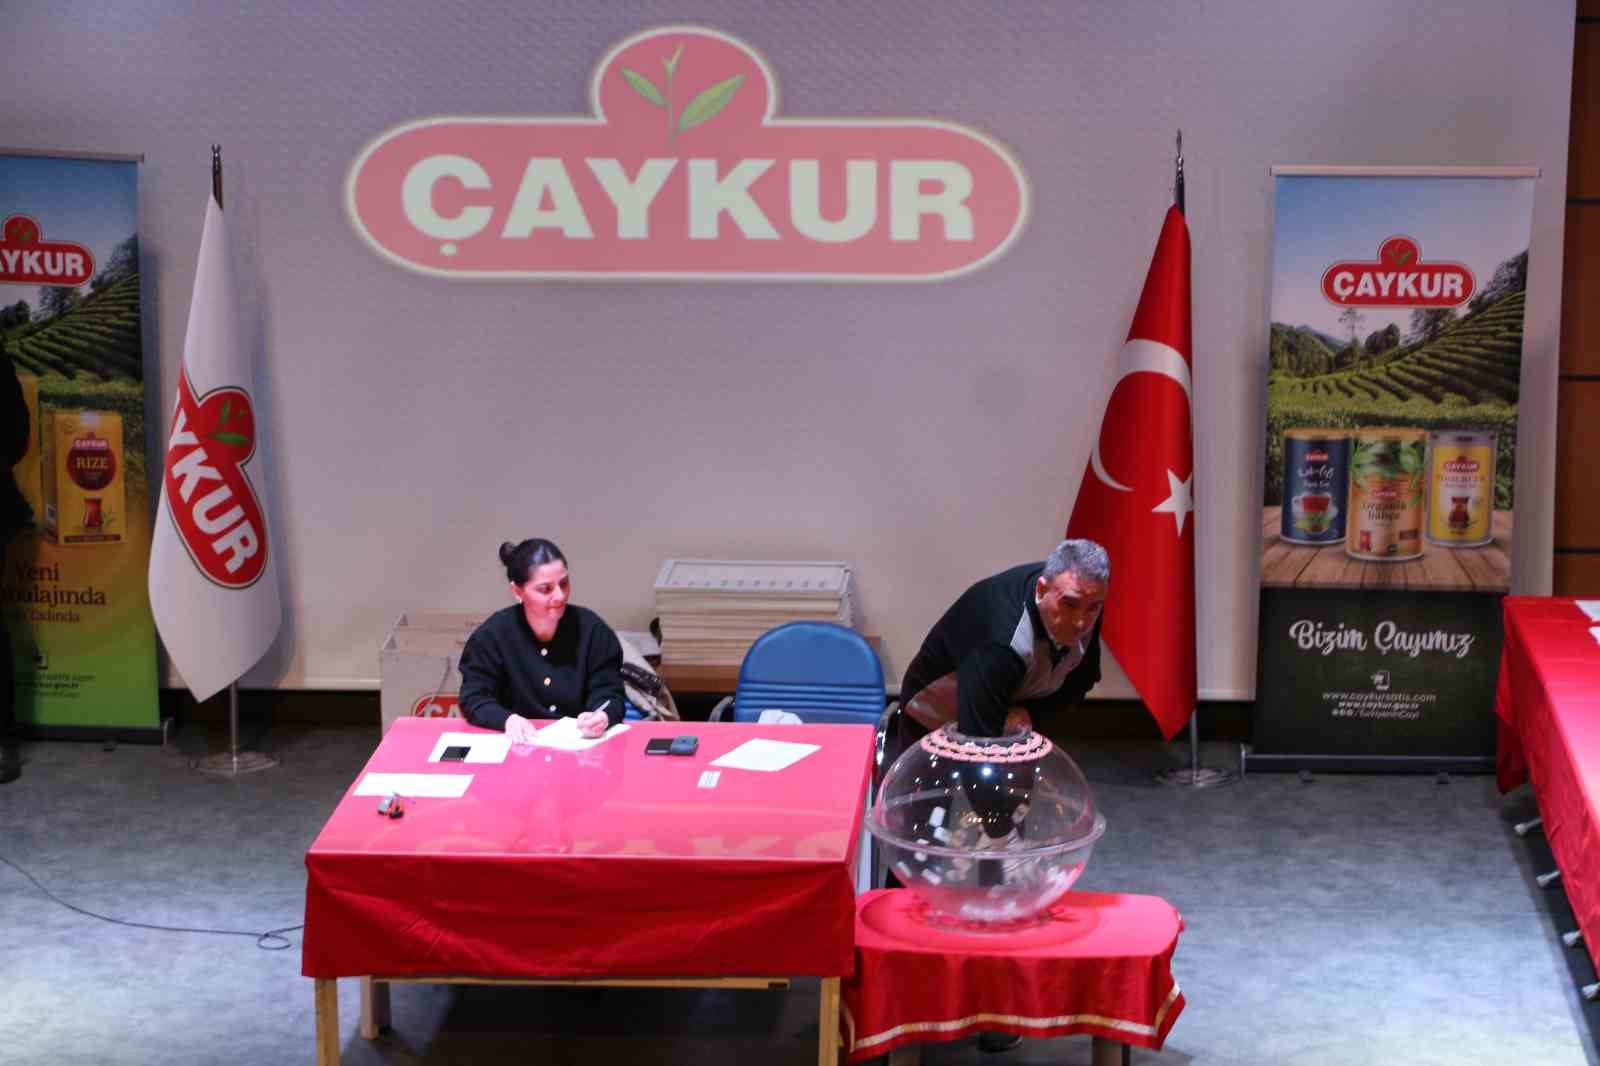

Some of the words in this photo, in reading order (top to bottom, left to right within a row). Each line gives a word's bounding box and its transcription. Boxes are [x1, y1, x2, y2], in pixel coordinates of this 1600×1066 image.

[402, 154, 975, 257] ÇAYKUR
[0, 250, 85, 277] YKUR
[1333, 271, 1464, 302] ÇAYKUR
[168, 407, 259, 574] YKUR
[1289, 620, 1368, 655] Bizim
[1374, 621, 1475, 658] Çayımız
